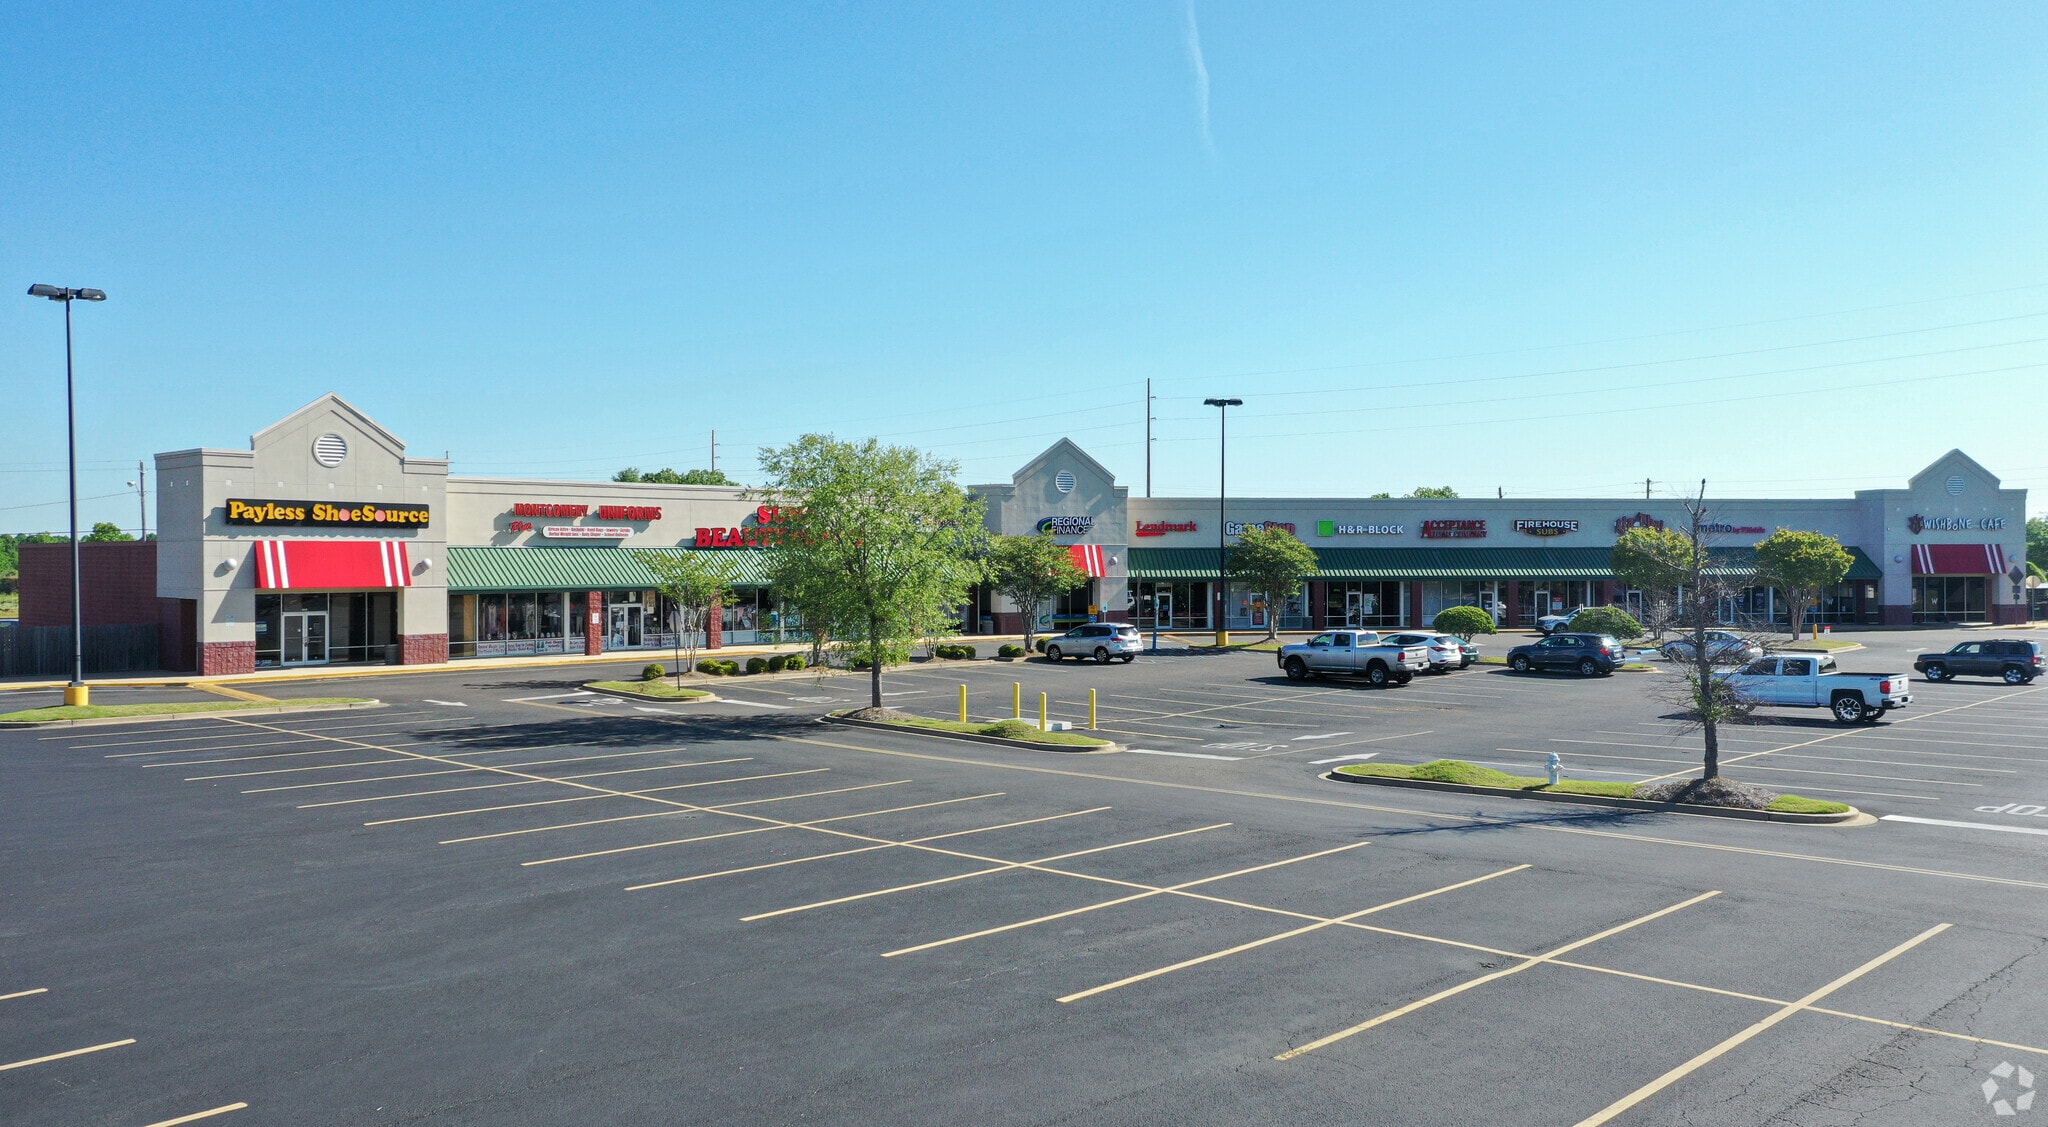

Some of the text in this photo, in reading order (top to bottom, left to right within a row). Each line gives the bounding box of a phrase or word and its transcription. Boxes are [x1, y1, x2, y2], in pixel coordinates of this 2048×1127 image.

[229, 500, 429, 524] Payless ShoeSource
[514, 502, 662, 520] MONTGOMERY UNIFORMS
[1051, 516, 1096, 526] REGIONAL
[1135, 520, 1198, 532] Lendmark
[1516, 519, 1579, 532] FIREHOUSE
[1980, 517, 2007, 531] CAFE
[1053, 525, 1089, 535] FINANCE
[1338, 524, 1404, 534] H&R BLOCK
[1420, 519, 1487, 539] ACCEPTANCE
[1698, 522, 1733, 534] metro
